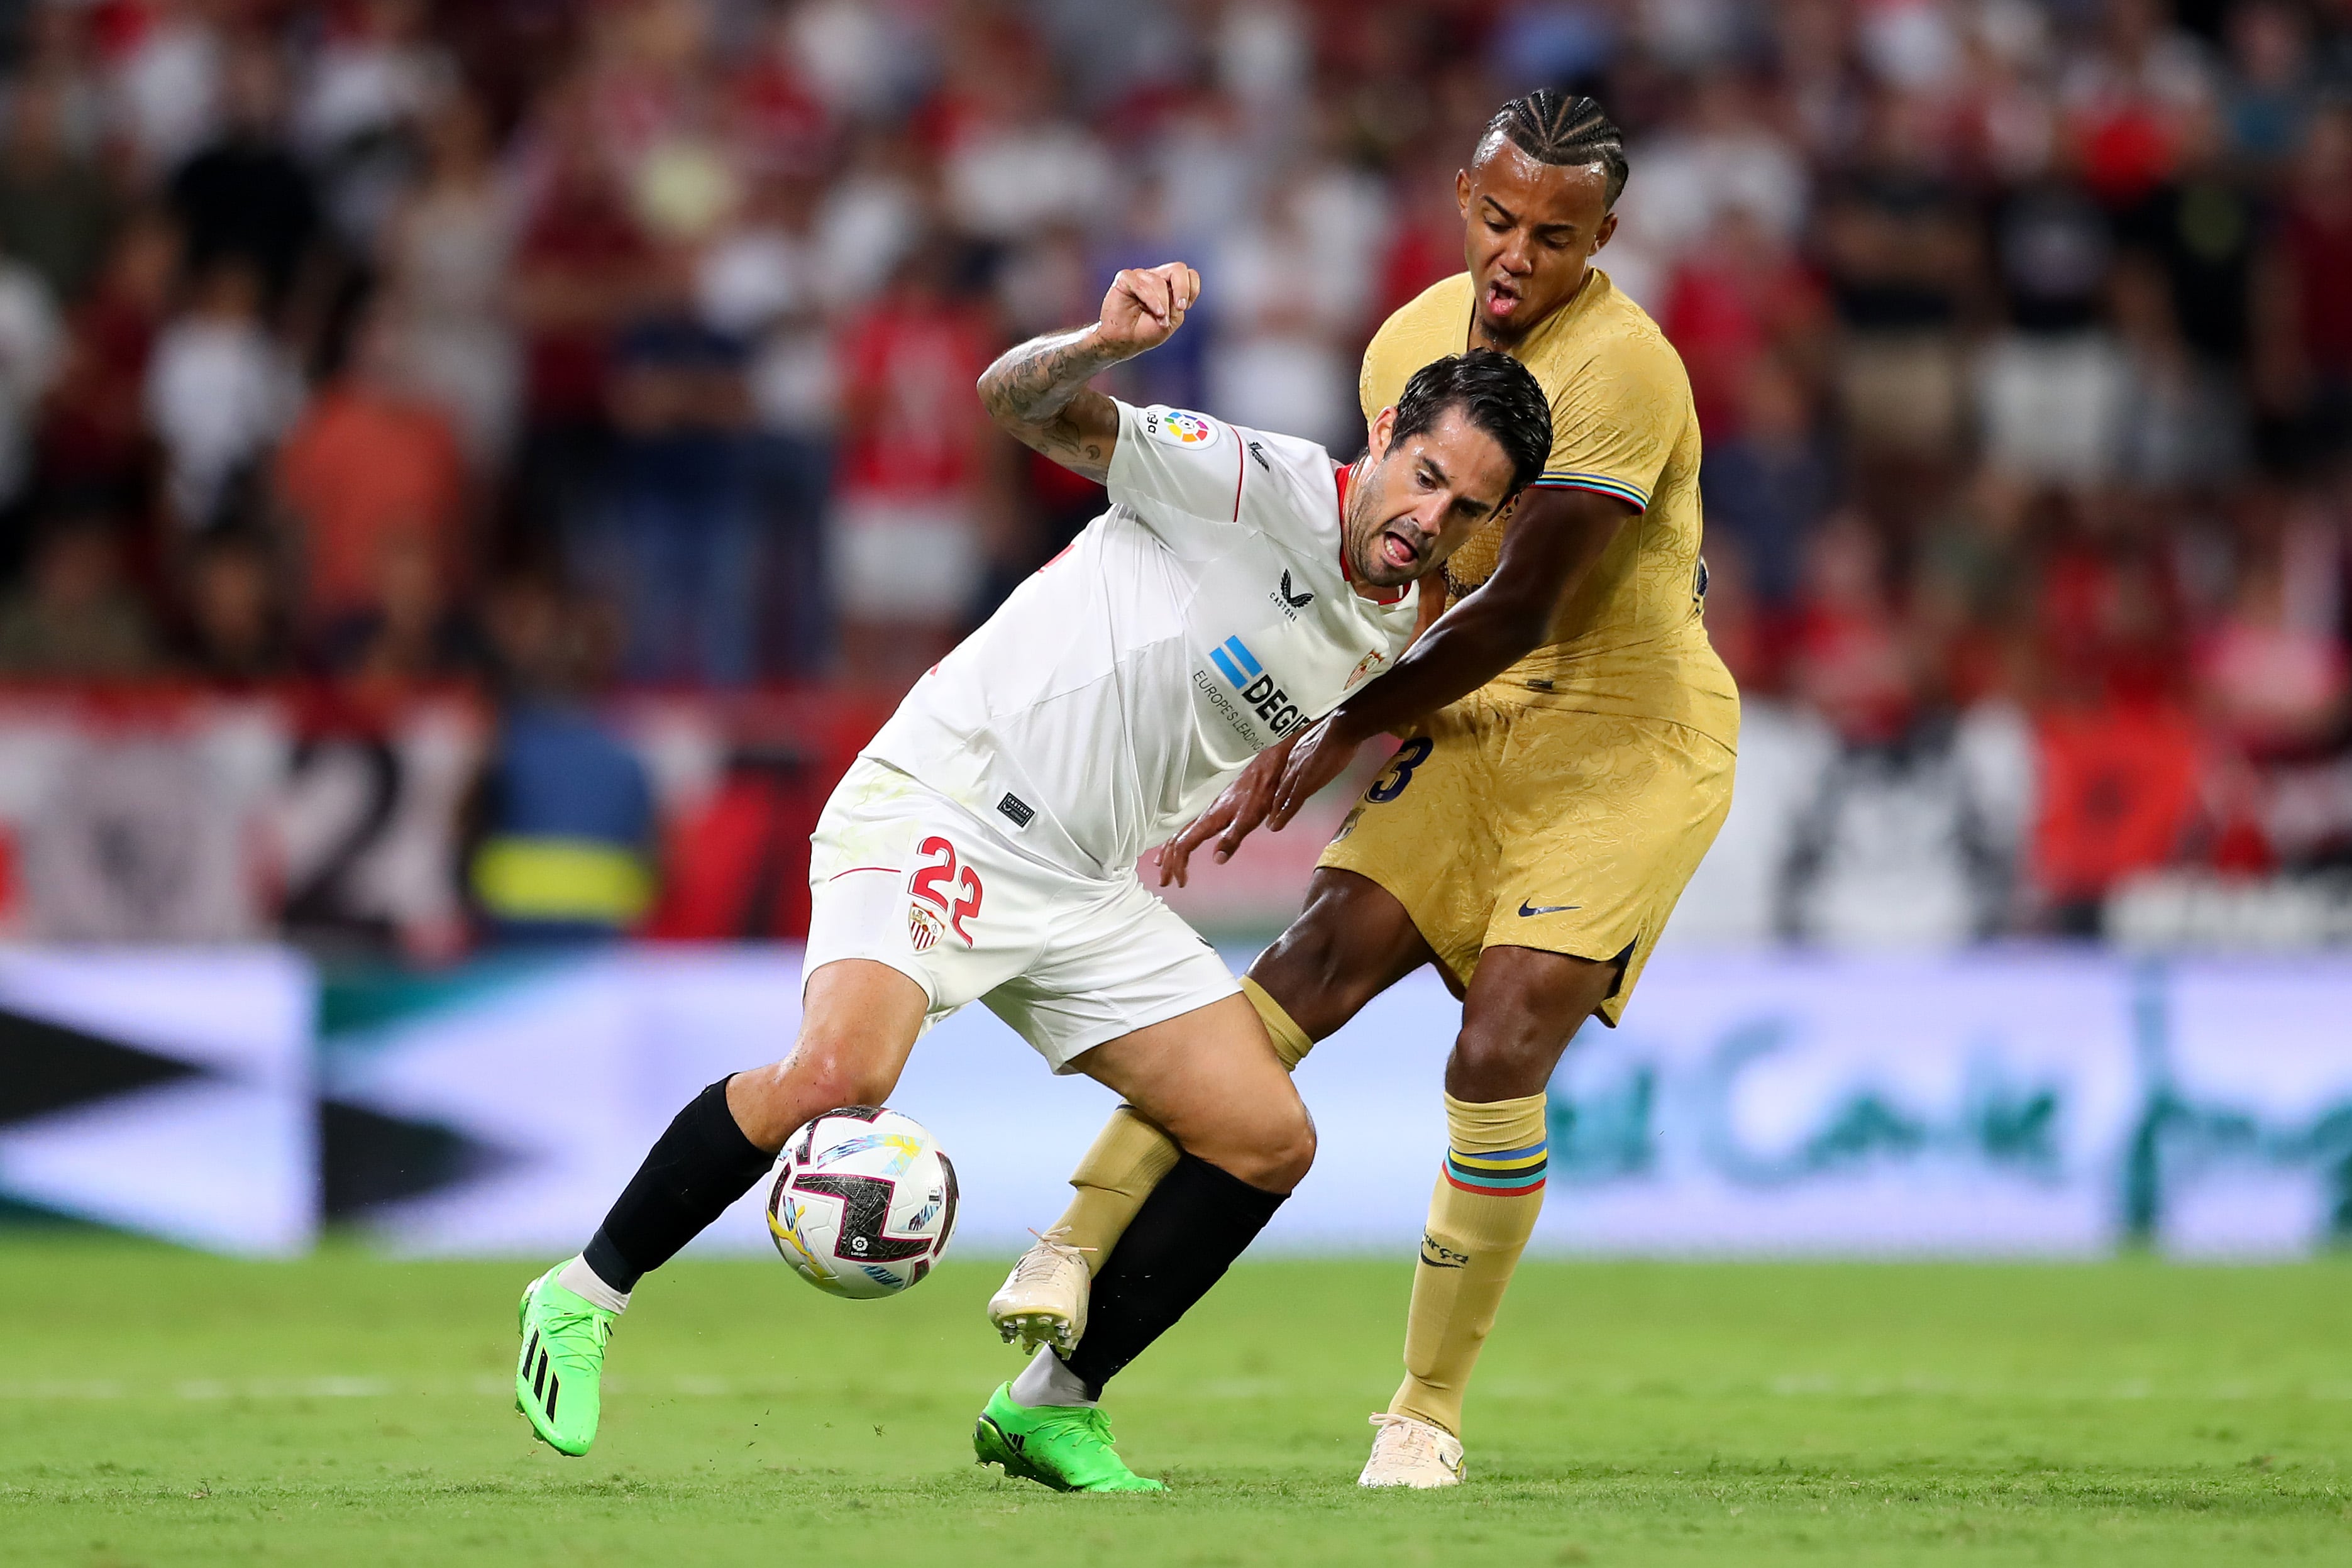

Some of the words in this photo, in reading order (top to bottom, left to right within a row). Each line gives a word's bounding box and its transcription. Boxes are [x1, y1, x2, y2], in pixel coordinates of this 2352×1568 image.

[1269, 592, 1297, 622] CASTORE
[1193, 670, 1239, 721] EUROPE'S
[1364, 736, 1434, 803] 3
[907, 836, 983, 950] 22
[1423, 1225, 1469, 1264] arça
